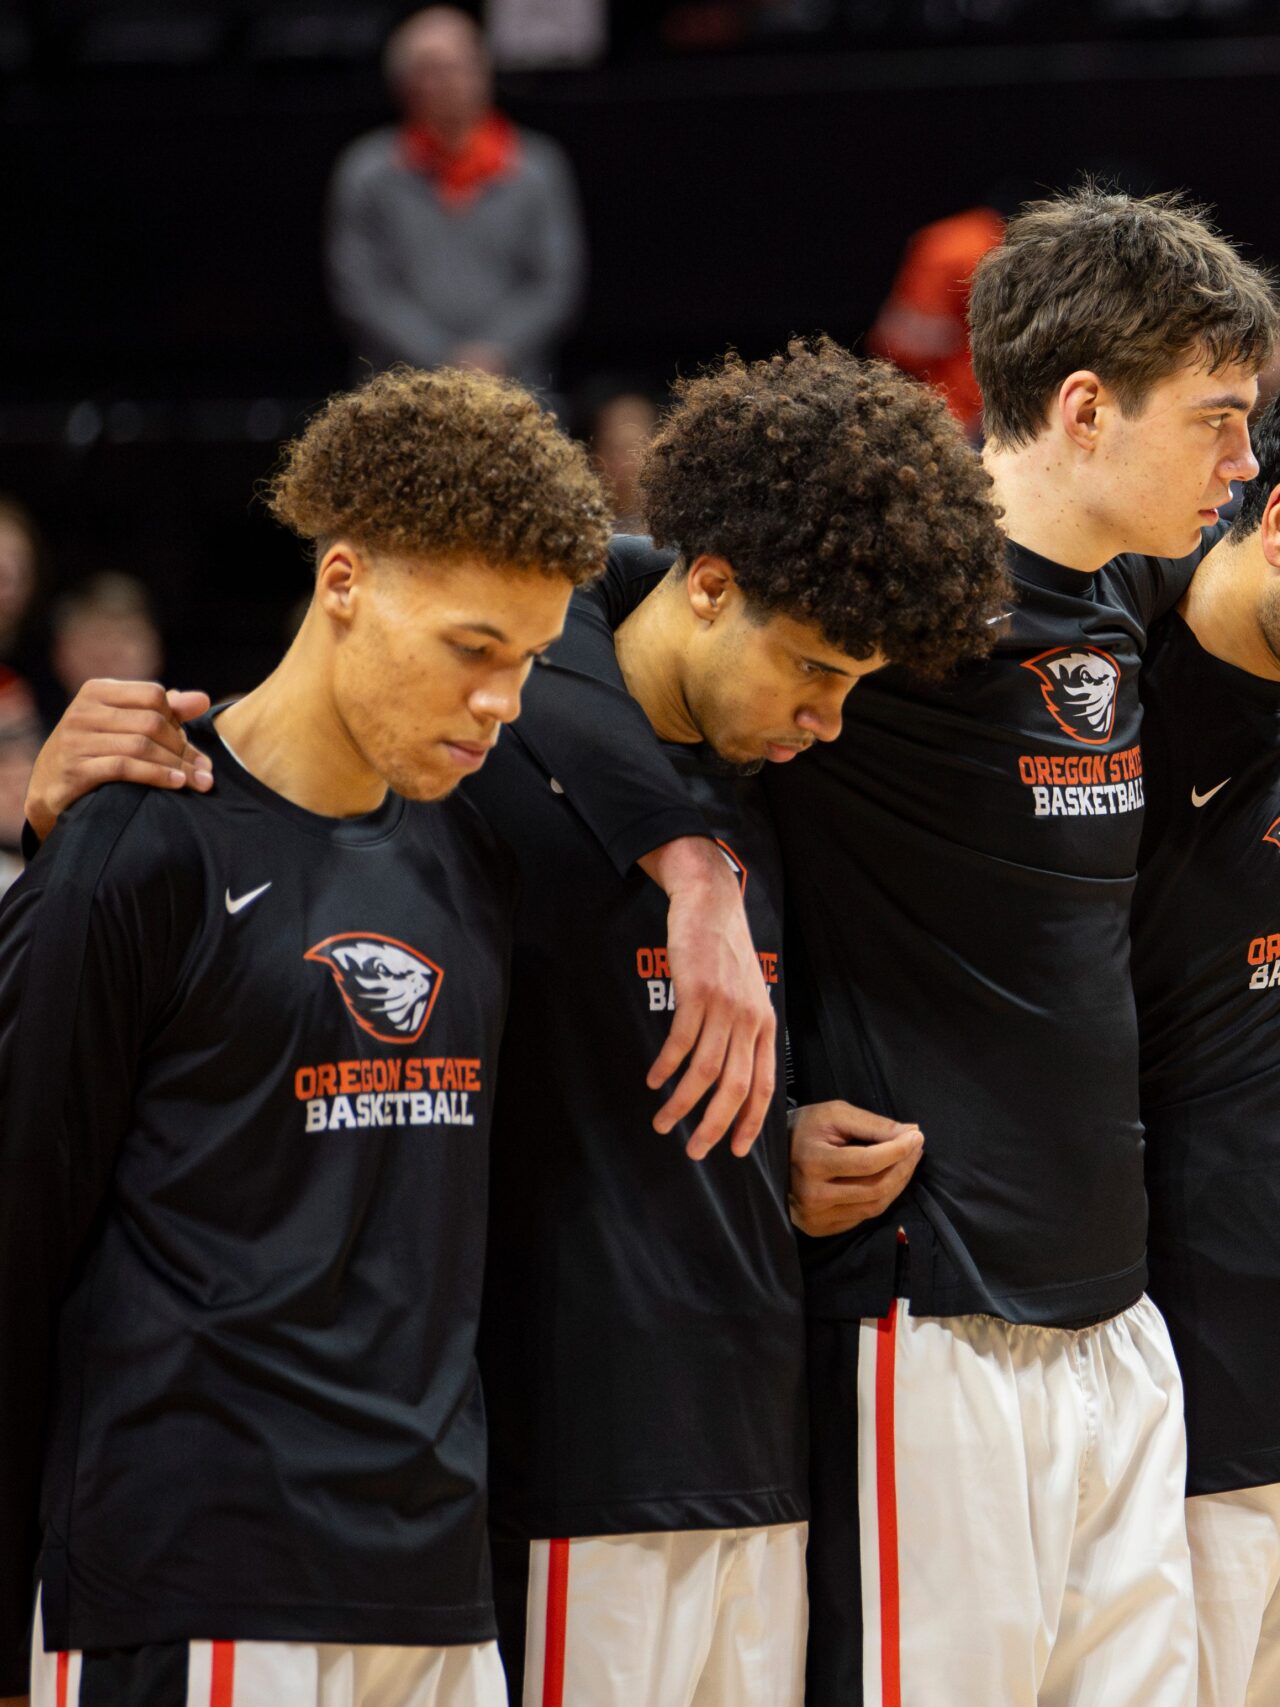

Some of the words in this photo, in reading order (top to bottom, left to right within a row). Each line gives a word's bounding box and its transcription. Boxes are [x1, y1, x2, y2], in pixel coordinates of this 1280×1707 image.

[1018, 755, 1108, 785] OREGON
[1032, 777, 1145, 816] BASKETBALL
[294, 1058, 402, 1101] OREGON
[404, 1057, 482, 1092] STATE
[305, 1091, 474, 1133] BASKETBALL
